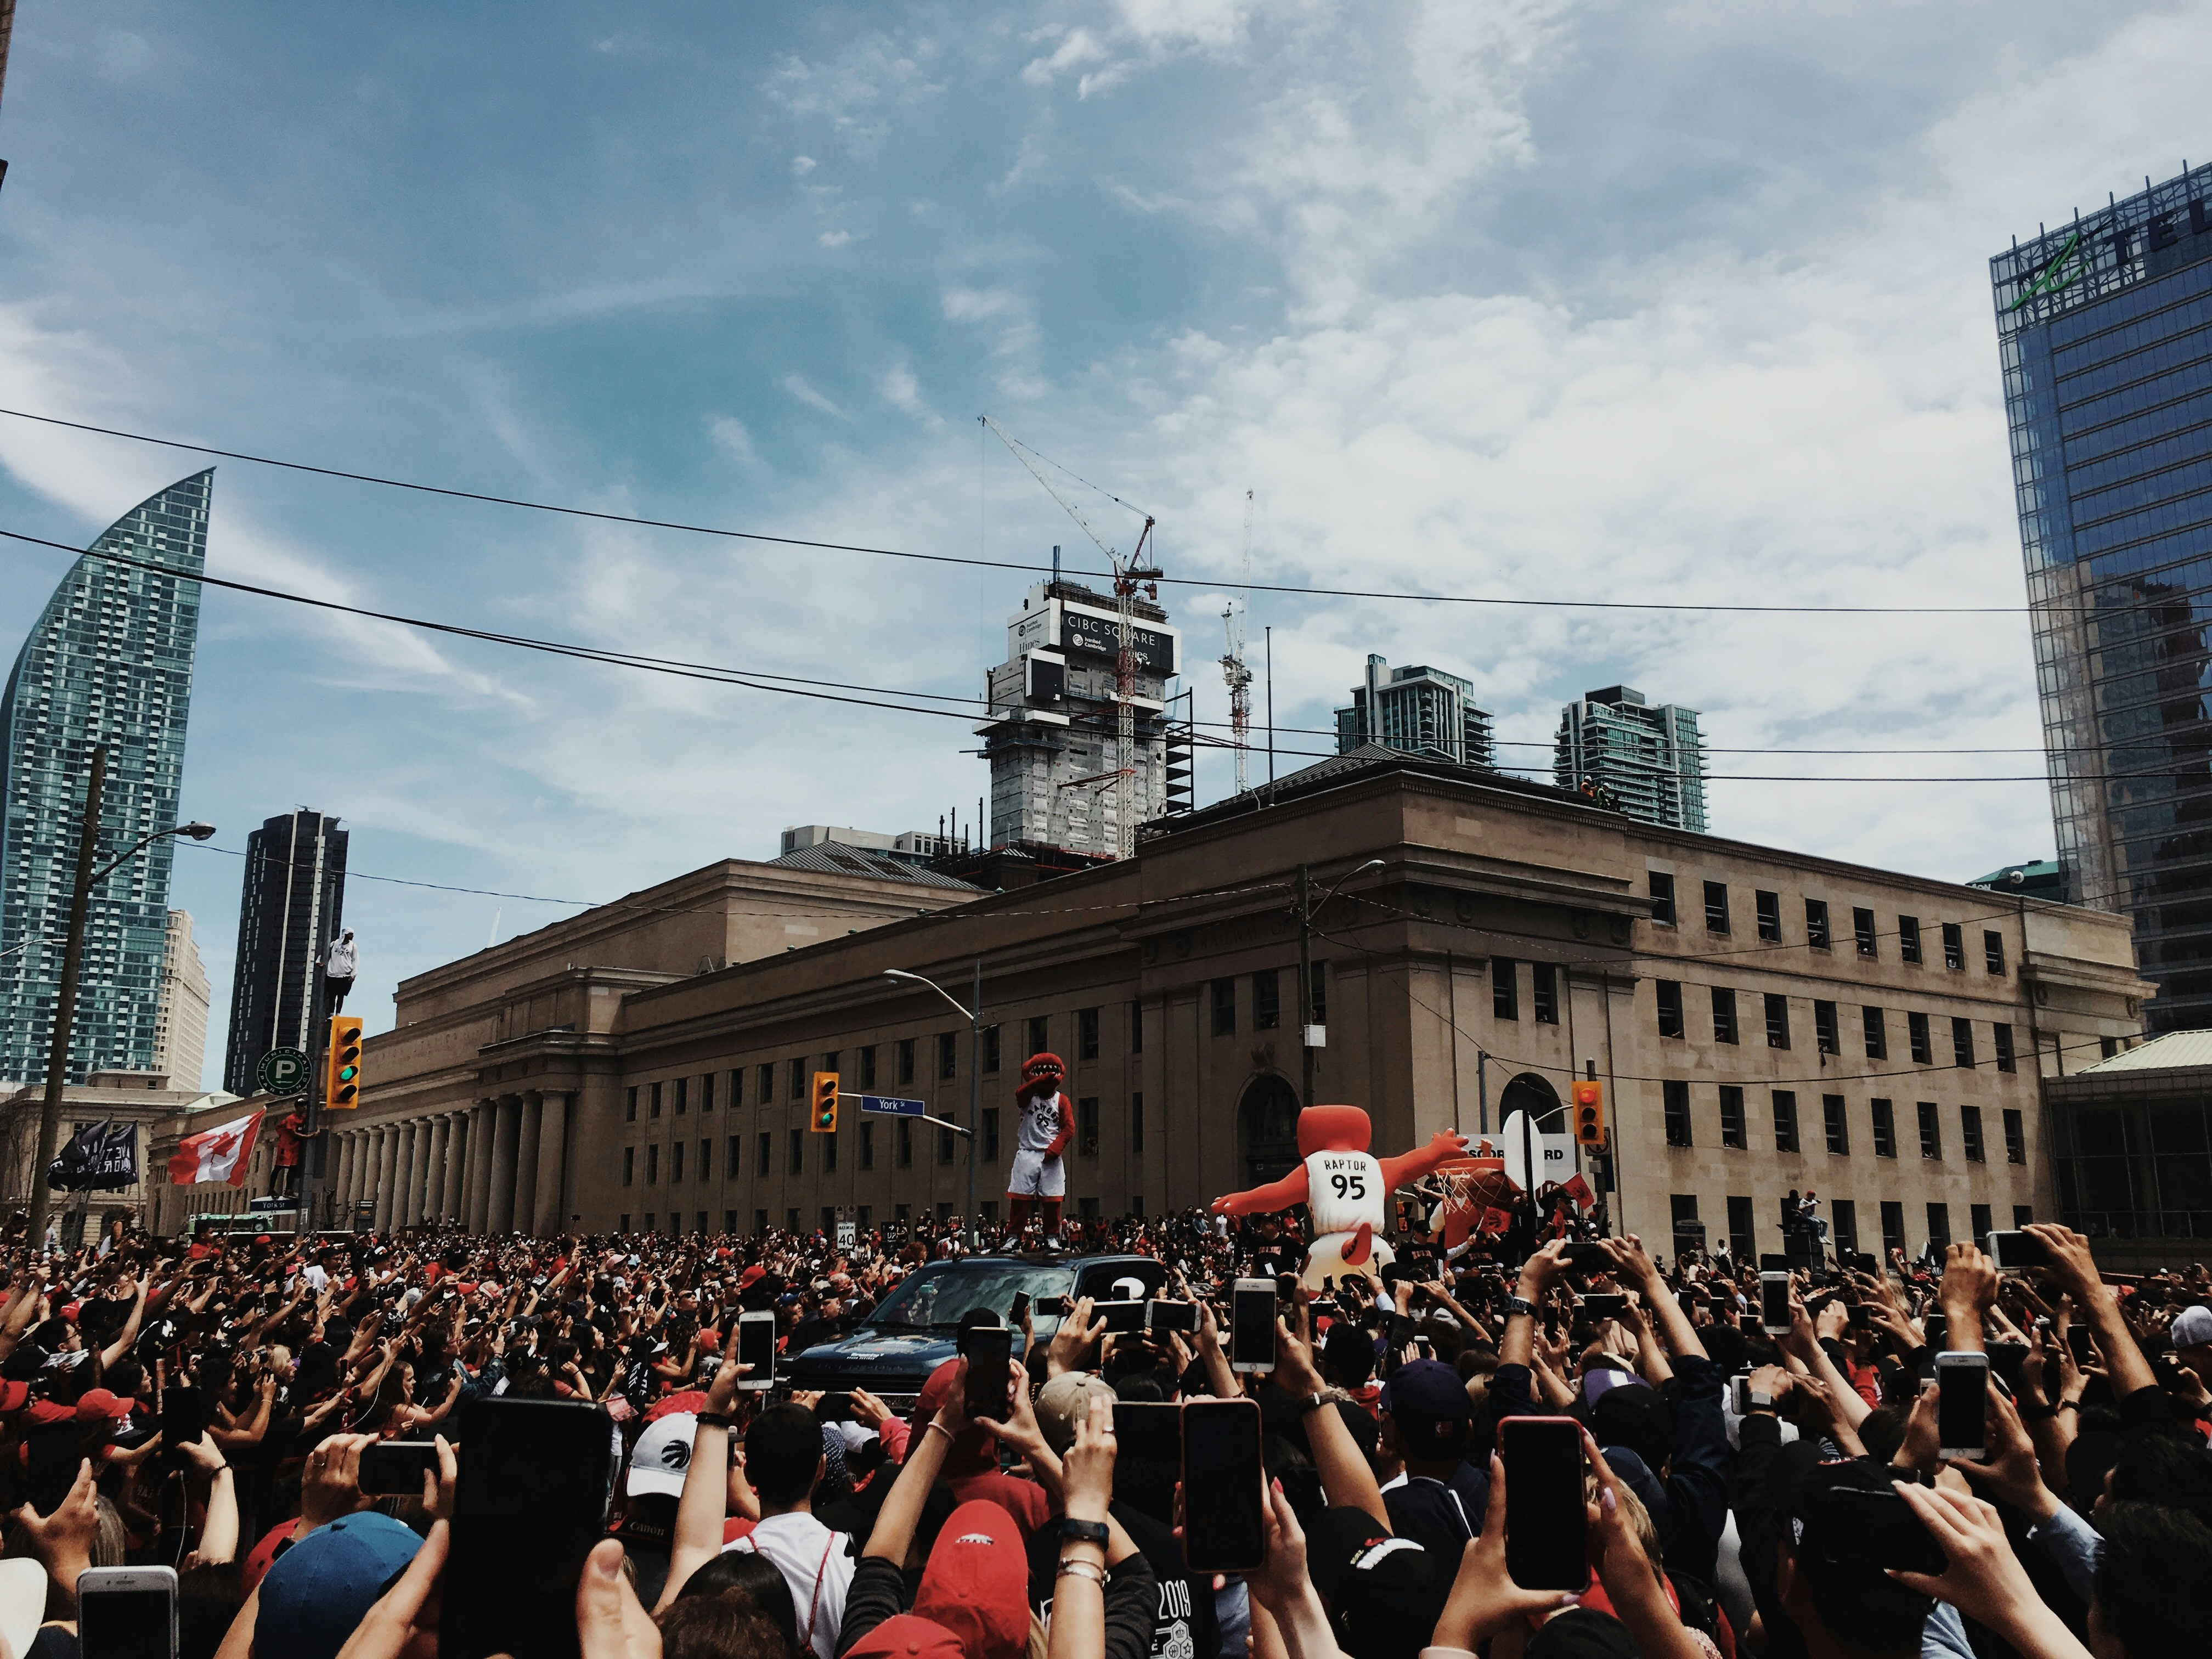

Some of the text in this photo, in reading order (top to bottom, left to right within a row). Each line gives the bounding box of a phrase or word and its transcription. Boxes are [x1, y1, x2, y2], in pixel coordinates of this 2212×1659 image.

[2103, 199, 2212, 266] TEL
[1068, 616, 1155, 646] CIBC SQARE
[1019, 638, 1040, 653] Hines
[261, 1049, 309, 1070] MUNICIPAL
[275, 1060, 296, 1078] P
[260, 1075, 307, 1094] PARKING
[879, 1099, 898, 1110] York
[1036, 1113, 1051, 1127] 95
[1324, 1159, 1366, 1172] RAPTOR
[1331, 1174, 1365, 1200] 95
[839, 1233, 854, 1245] 40
[630, 1521, 664, 1536] Canon
[1158, 1579, 1191, 1620] 2019
